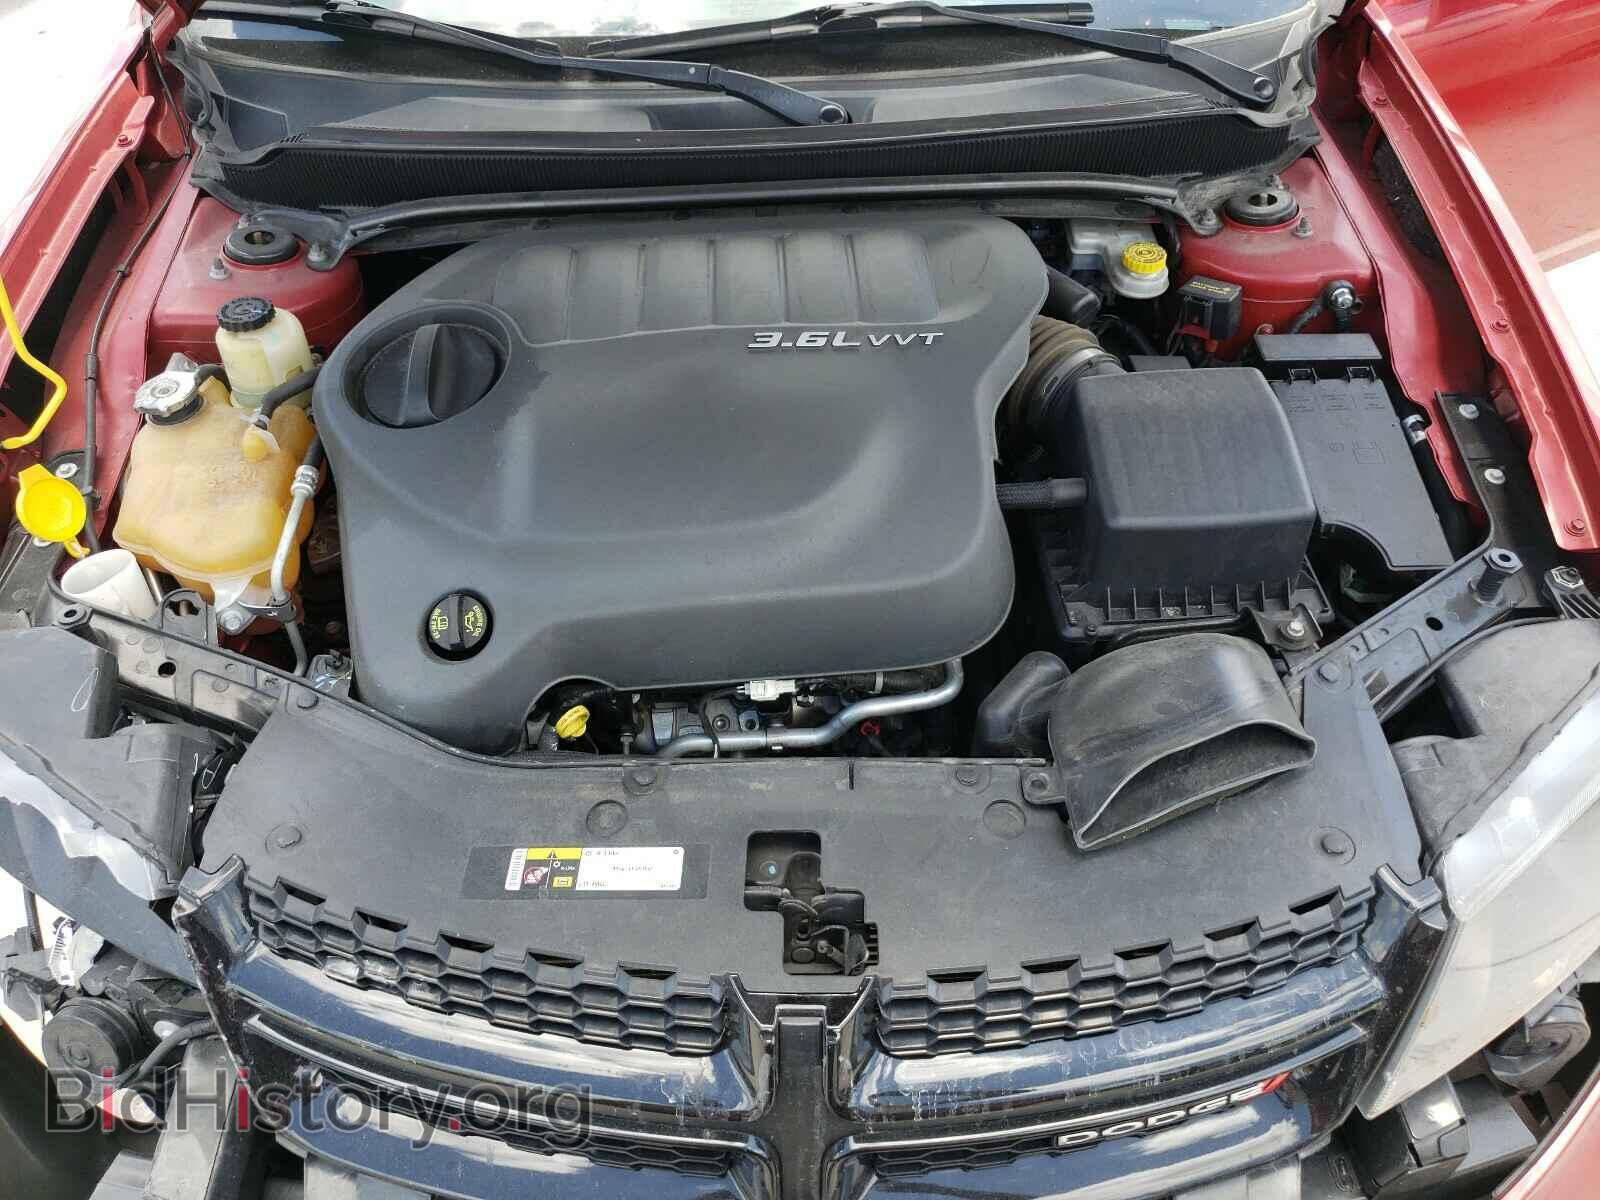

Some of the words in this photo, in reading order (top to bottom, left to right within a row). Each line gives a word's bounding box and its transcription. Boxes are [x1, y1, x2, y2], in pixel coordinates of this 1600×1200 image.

[748, 331, 861, 348] 3.6L
[868, 332, 944, 346] VVT
[1057, 1084, 1264, 1147] DODGE
